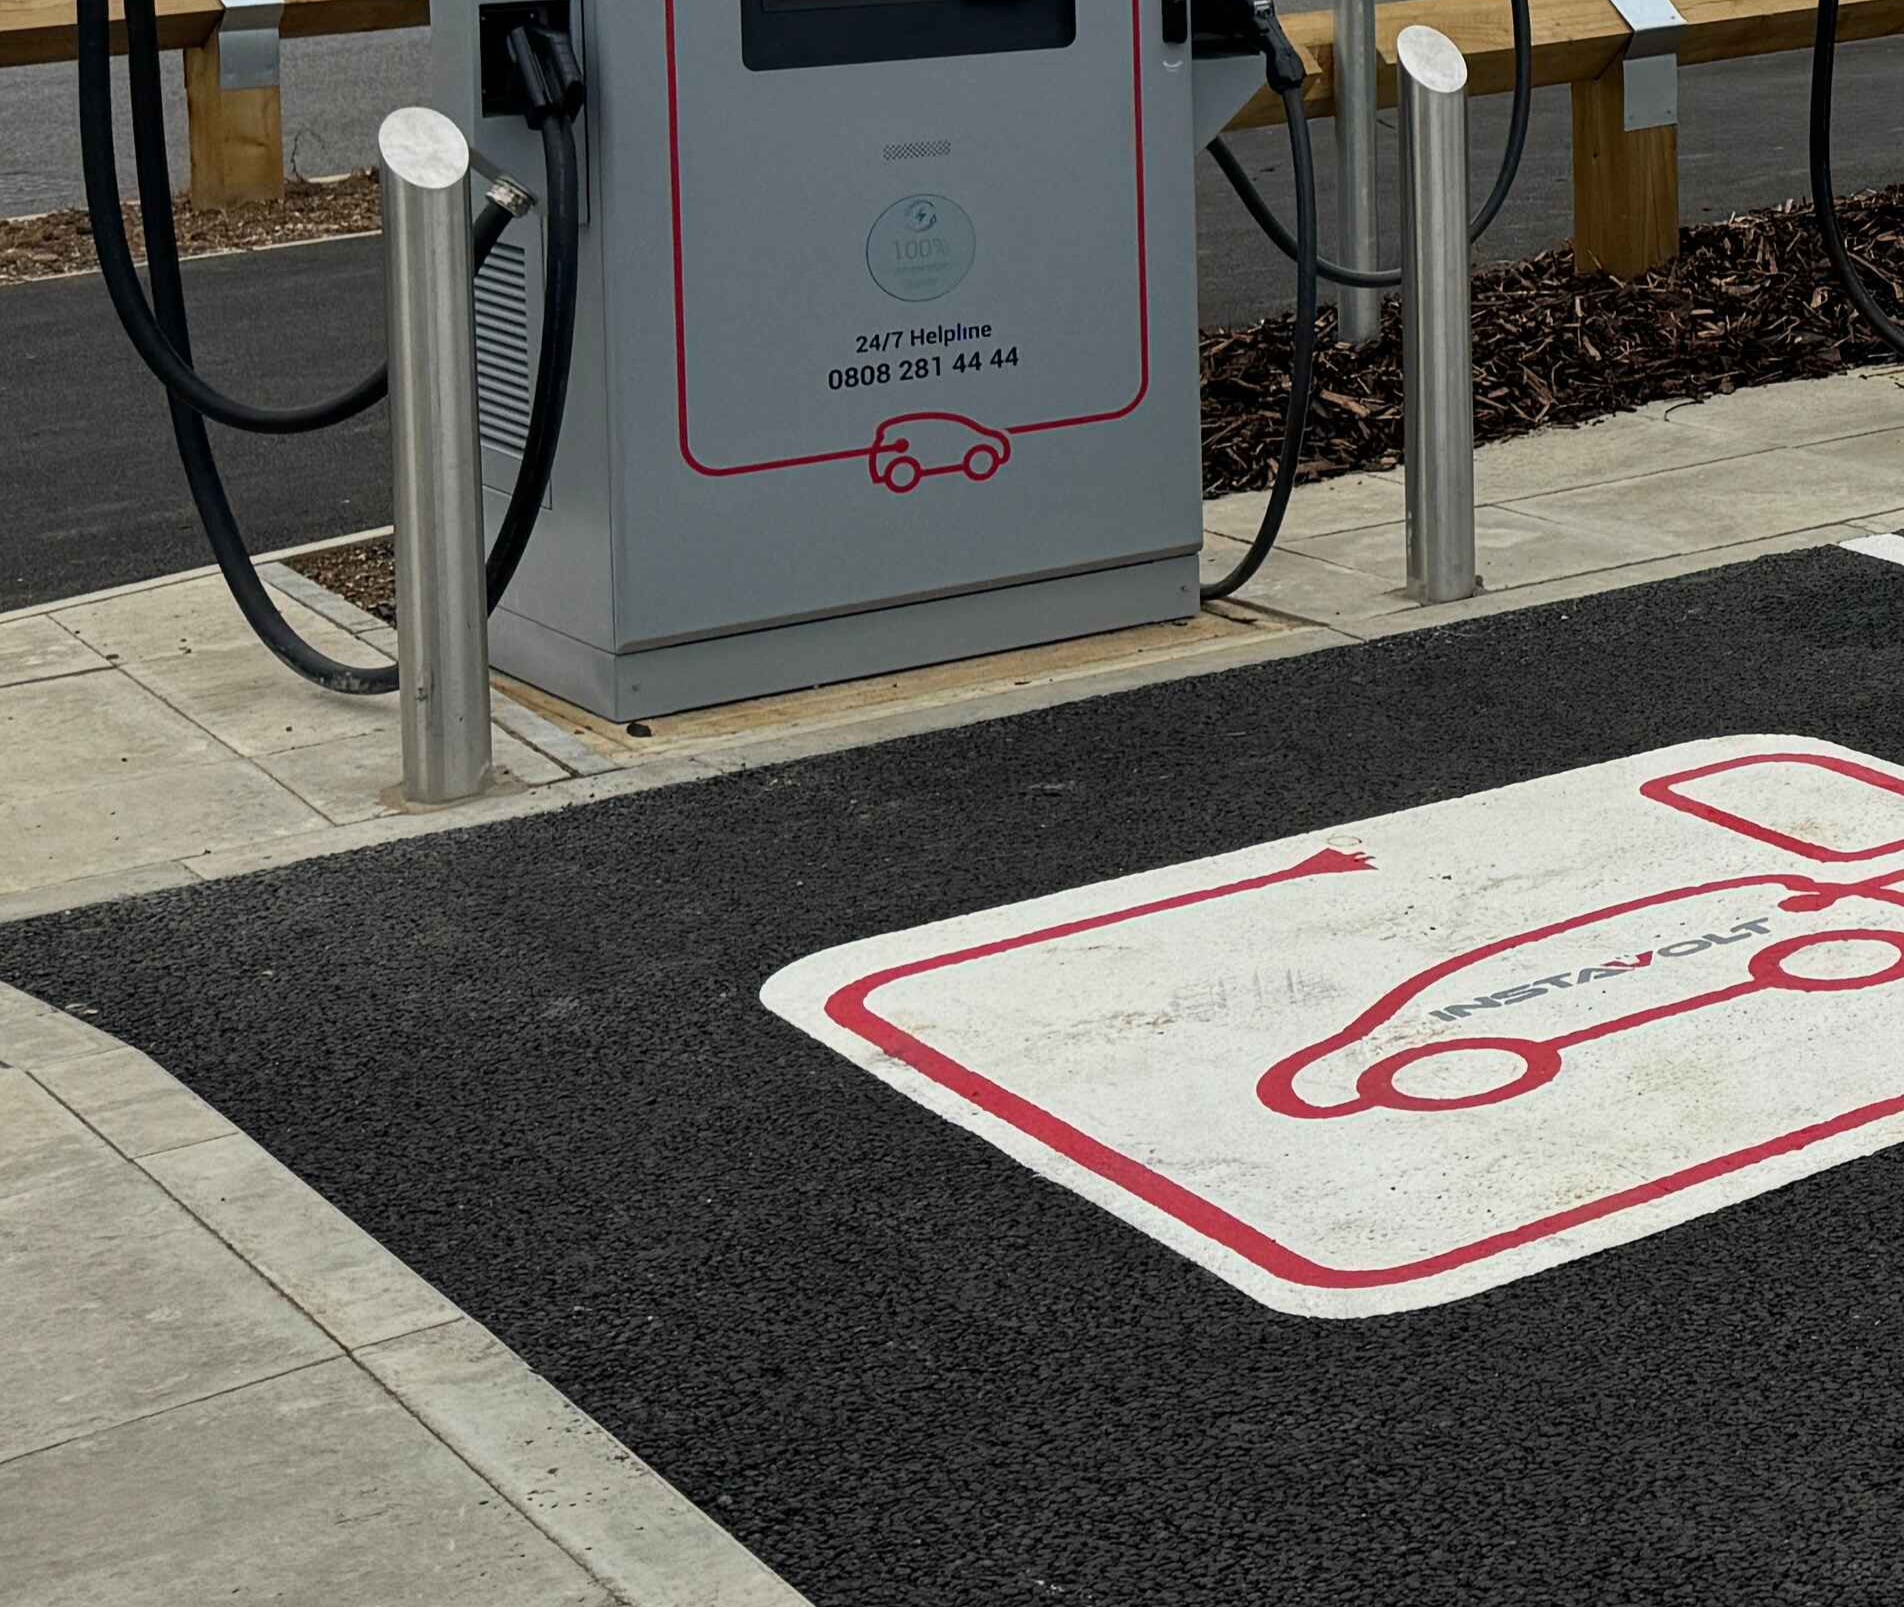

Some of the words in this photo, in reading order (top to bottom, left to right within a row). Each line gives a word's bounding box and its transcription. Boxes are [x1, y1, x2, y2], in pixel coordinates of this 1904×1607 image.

[856, 330, 905, 355] 24/7
[909, 320, 992, 349] Helpline
[828, 363, 891, 391] 0808
[898, 354, 944, 381] 281
[951, 350, 983, 375] 44
[989, 345, 1020, 371] 44
[1428, 917, 1774, 1023] INSTAVOLT
